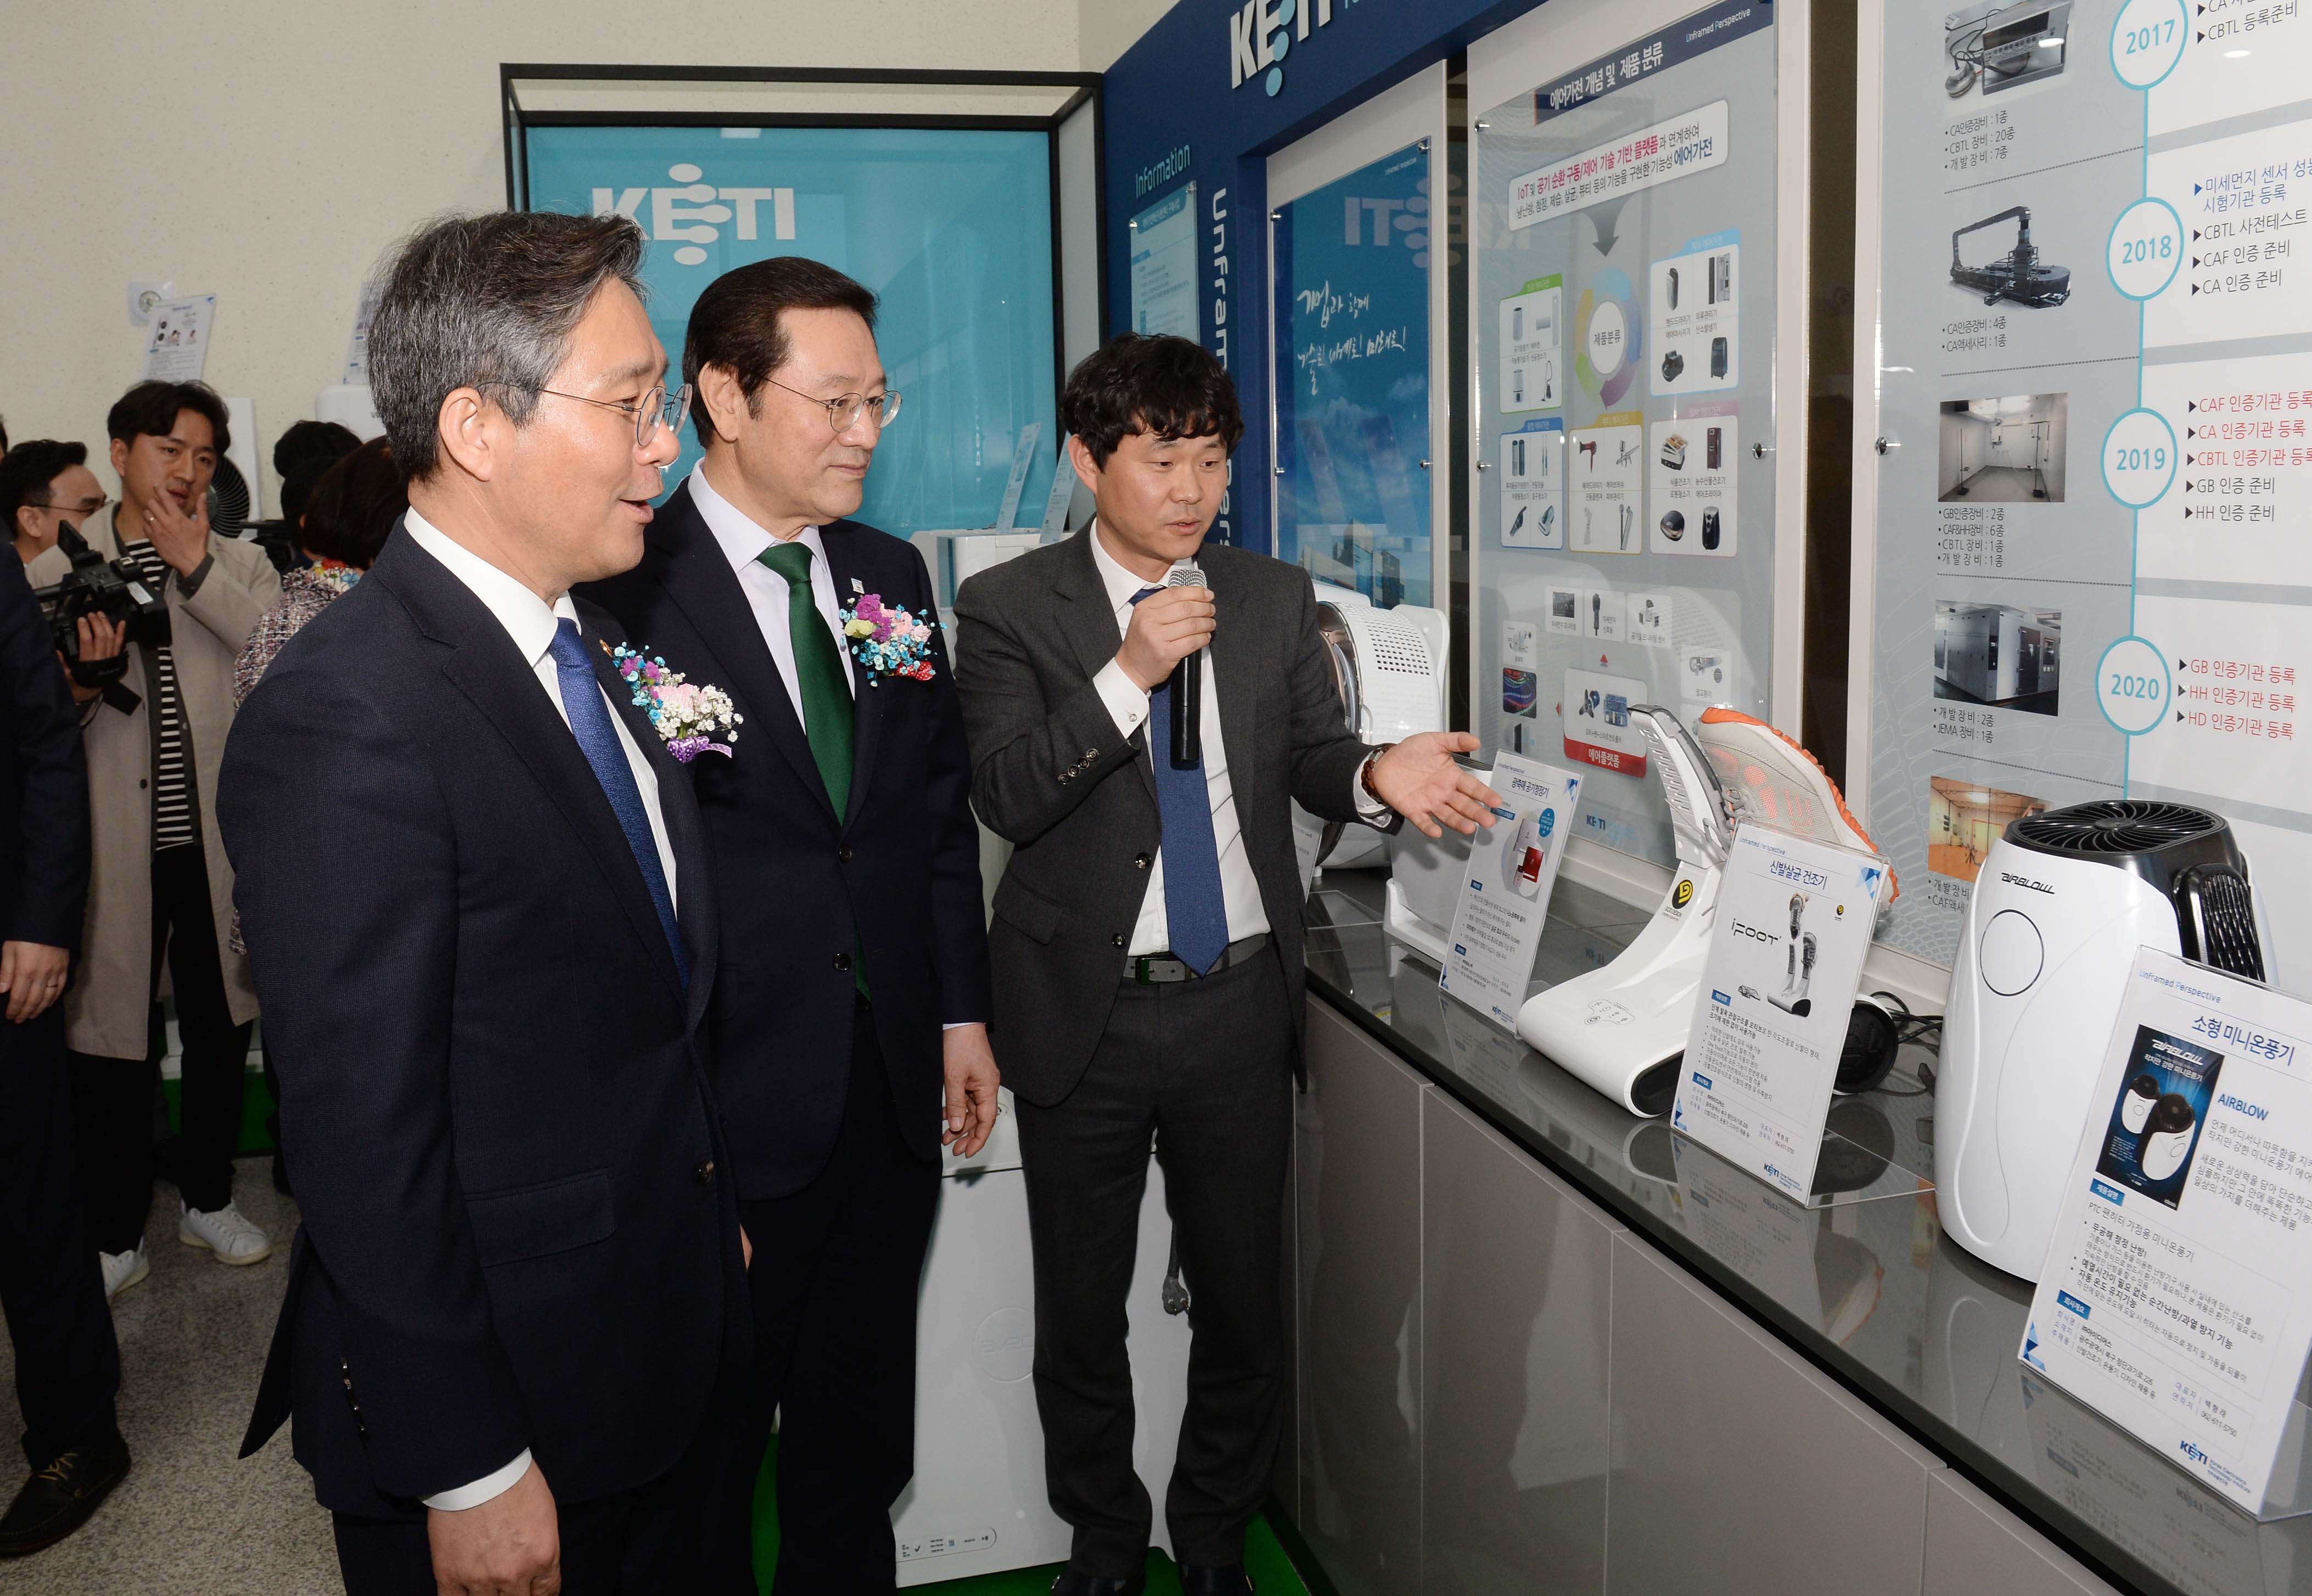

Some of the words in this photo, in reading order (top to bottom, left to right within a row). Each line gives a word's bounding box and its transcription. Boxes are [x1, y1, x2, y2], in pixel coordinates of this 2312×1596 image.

[1686, 23, 1714, 42] Unframed
[1715, 8, 1750, 30] Perspective
[2208, 19, 2240, 40] CBTL
[2243, 0, 2297, 31] 등록준비
[2126, 19, 2175, 55] 2017
[1550, 78, 1584, 110] 에어가전
[1585, 67, 1604, 95] 개념
[1606, 63, 1615, 88] 및
[1620, 52, 1641, 78] 제품
[1642, 41, 1663, 71] 분류
[1950, 115, 1988, 137] CA인증장비
[1996, 110, 2007, 124] 1종
[1950, 140, 1969, 154] CBTL
[1972, 133, 1987, 149] 장비
[1995, 126, 2015, 142] 20종
[1995, 145, 2007, 159] 7종
[1135, 144, 1191, 198] Information
[1537, 175, 1550, 195] 공기
[1551, 169, 1565, 189] 순환
[1567, 157, 1597, 183] 구동/제어
[1600, 151, 1615, 171] 기술
[1617, 144, 1632, 165] 기반
[1579, 183, 1591, 194] 뷰티
[1593, 176, 1606, 194] 등의
[1607, 169, 1628, 187] 기능을
[1629, 161, 1650, 181] 구현한
[1651, 154, 1673, 173] 기능성
[1674, 136, 1712, 165] 에어가전
[2206, 168, 2256, 194] 미세먼지
[2262, 162, 2287, 184] 센서
[2204, 189, 2255, 213] 시험기관
[2259, 184, 2286, 204] 등록
[2204, 222, 2236, 240] CBTL
[2240, 209, 2308, 235] 사전테스트
[2122, 235, 2171, 264] 2018
[2203, 250, 2229, 267] CAF
[2234, 245, 2259, 264] 인증
[2263, 239, 2289, 260] 준비
[2203, 279, 2221, 294] CA
[2226, 274, 2251, 293] 인증
[2255, 269, 2281, 289] 준비
[1593, 329, 1621, 346] 제품분류
[1947, 318, 1986, 335] CA인증장비
[1993, 316, 2006, 329] 4종
[1946, 336, 1987, 352] CA액세사리
[1995, 334, 2006, 347] 1종
[2199, 397, 2225, 413] CAF
[2230, 392, 2282, 412] 인증기관
[2286, 391, 2312, 409] 등록
[2198, 425, 2217, 439] CA
[2221, 421, 2274, 440] 인증기관
[2278, 420, 2305, 438] 등록
[2116, 447, 2165, 470] 2019
[2198, 452, 2229, 466] CBTL
[2233, 448, 2286, 467] 인증기관
[2197, 479, 2214, 493] GB
[2220, 477, 2244, 494] 인증
[2249, 477, 2274, 494] 준비
[1943, 508, 1984, 520] GB인증장비
[1991, 508, 2005, 521] 2종
[2196, 506, 2214, 519] HH
[2219, 504, 2244, 521] 인증
[2249, 505, 2274, 521] 준비
[1990, 524, 2005, 537] 6종
[1966, 539, 1983, 552] 장비
[1990, 540, 2004, 553] 1종
[1990, 554, 2004, 567] 1종
[2191, 659, 2208, 674] GB
[2213, 661, 2265, 682] 인증기관
[2269, 666, 2296, 685] 등록
[2111, 674, 2159, 700] 2020
[2190, 685, 2208, 700] HH
[2213, 687, 2264, 709] 인증기관
[2268, 694, 2295, 713] 등록
[1937, 723, 1958, 736] JEMA
[1959, 726, 1974, 740] 장비
[1982, 730, 1994, 744] 1종
[1981, 714, 1994, 727] 2종
[2188, 711, 2207, 726] HD
[2212, 713, 2263, 736] 인증기관
[2266, 721, 2293, 740] 등록
[1589, 749, 1620, 768] 에어플랫폼
[1770, 860, 1802, 881] 신발살균
[1803, 870, 1828, 890] 건조기
[2140, 973, 2175, 987] Unframed
[2176, 982, 2221, 1003] Perspective
[2192, 1016, 2222, 1039] 소형
[2223, 1025, 2295, 1066] 미니온풍기
[2217, 1094, 2269, 1121] AIRBLOW
[2089, 1202, 2101, 1214] PTC
[2126, 1220, 2151, 1240] 가정용
[2152, 1233, 2194, 1261] 미니온풍기
[2092, 1223, 2113, 1240] 무공해
[2114, 1234, 2129, 1249] 청정
[2078, 1269, 2092, 1283] 자동
[2094, 1278, 2107, 1291] 온도
[2108, 1286, 2137, 1308] 유지기능
[2082, 1258, 2117, 1284] 예열시간이
[2118, 1278, 2131, 1292] 필요
[2133, 1287, 2147, 1302] 없는
[2149, 1297, 2198, 1330] 순간난방/과열
[2199, 1324, 2215, 1340] 방지
[2216, 1334, 2233, 1350] 기능
